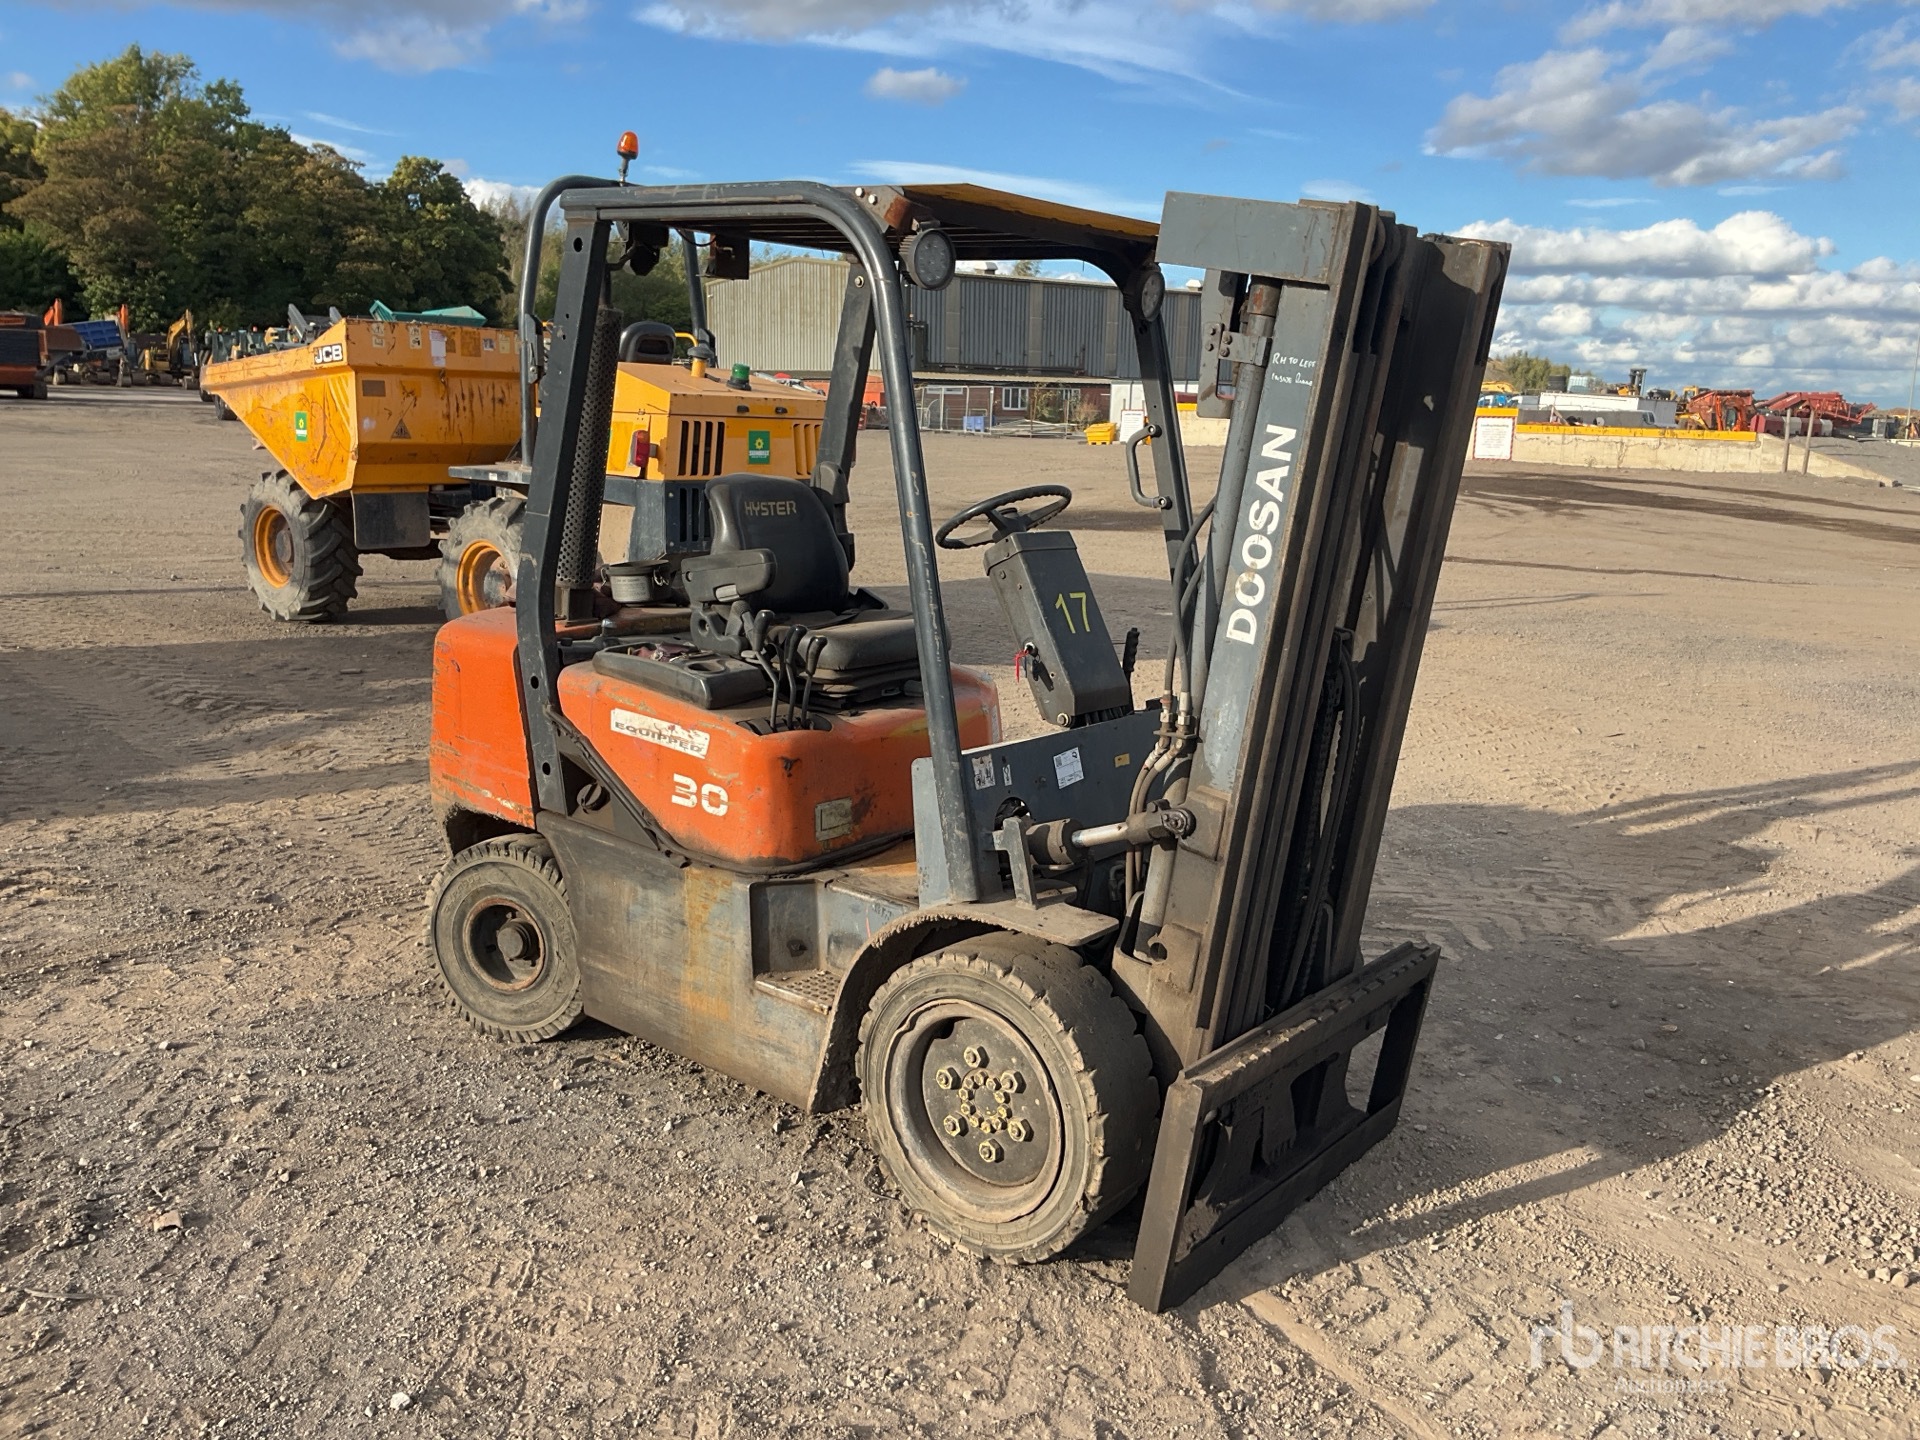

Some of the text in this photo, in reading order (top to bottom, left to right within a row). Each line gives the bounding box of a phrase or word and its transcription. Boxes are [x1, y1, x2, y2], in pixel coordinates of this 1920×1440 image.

[314, 344, 343, 364] JCB
[1272, 352, 1287, 365] RH
[744, 500, 797, 516] HYSTER
[1226, 424, 1297, 645] DOOSAN
[1055, 592, 1091, 634] 17
[614, 721, 705, 753] EQUIPPED
[671, 772, 729, 817] 30
